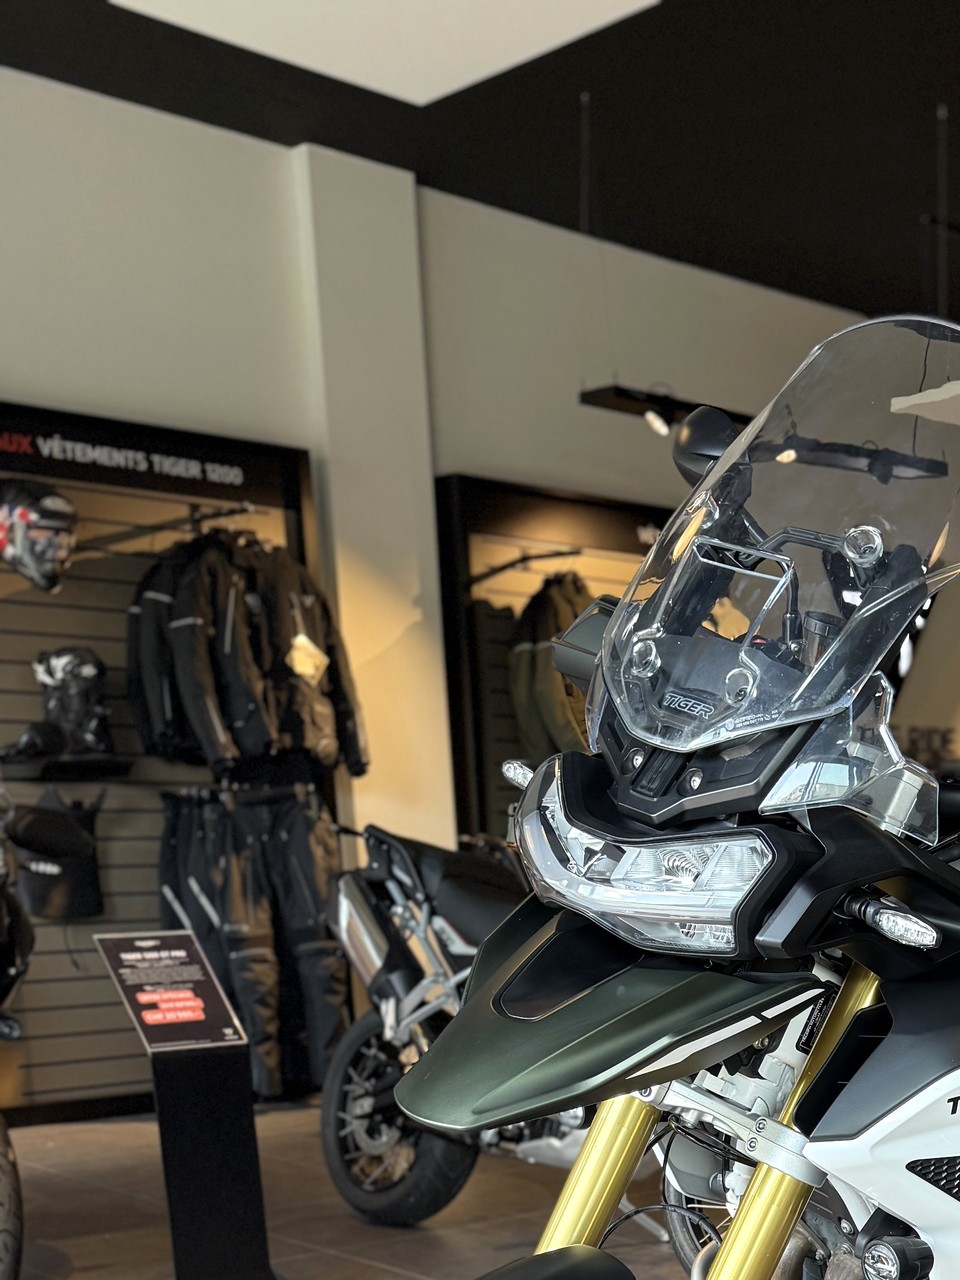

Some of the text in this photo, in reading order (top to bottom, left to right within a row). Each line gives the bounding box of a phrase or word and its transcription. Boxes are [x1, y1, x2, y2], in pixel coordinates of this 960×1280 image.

[35, 433, 149, 472] VÊTEMENTS
[149, 453, 203, 480] TIGER
[203, 462, 244, 486] 1200
[663, 692, 715, 720] TIGER
